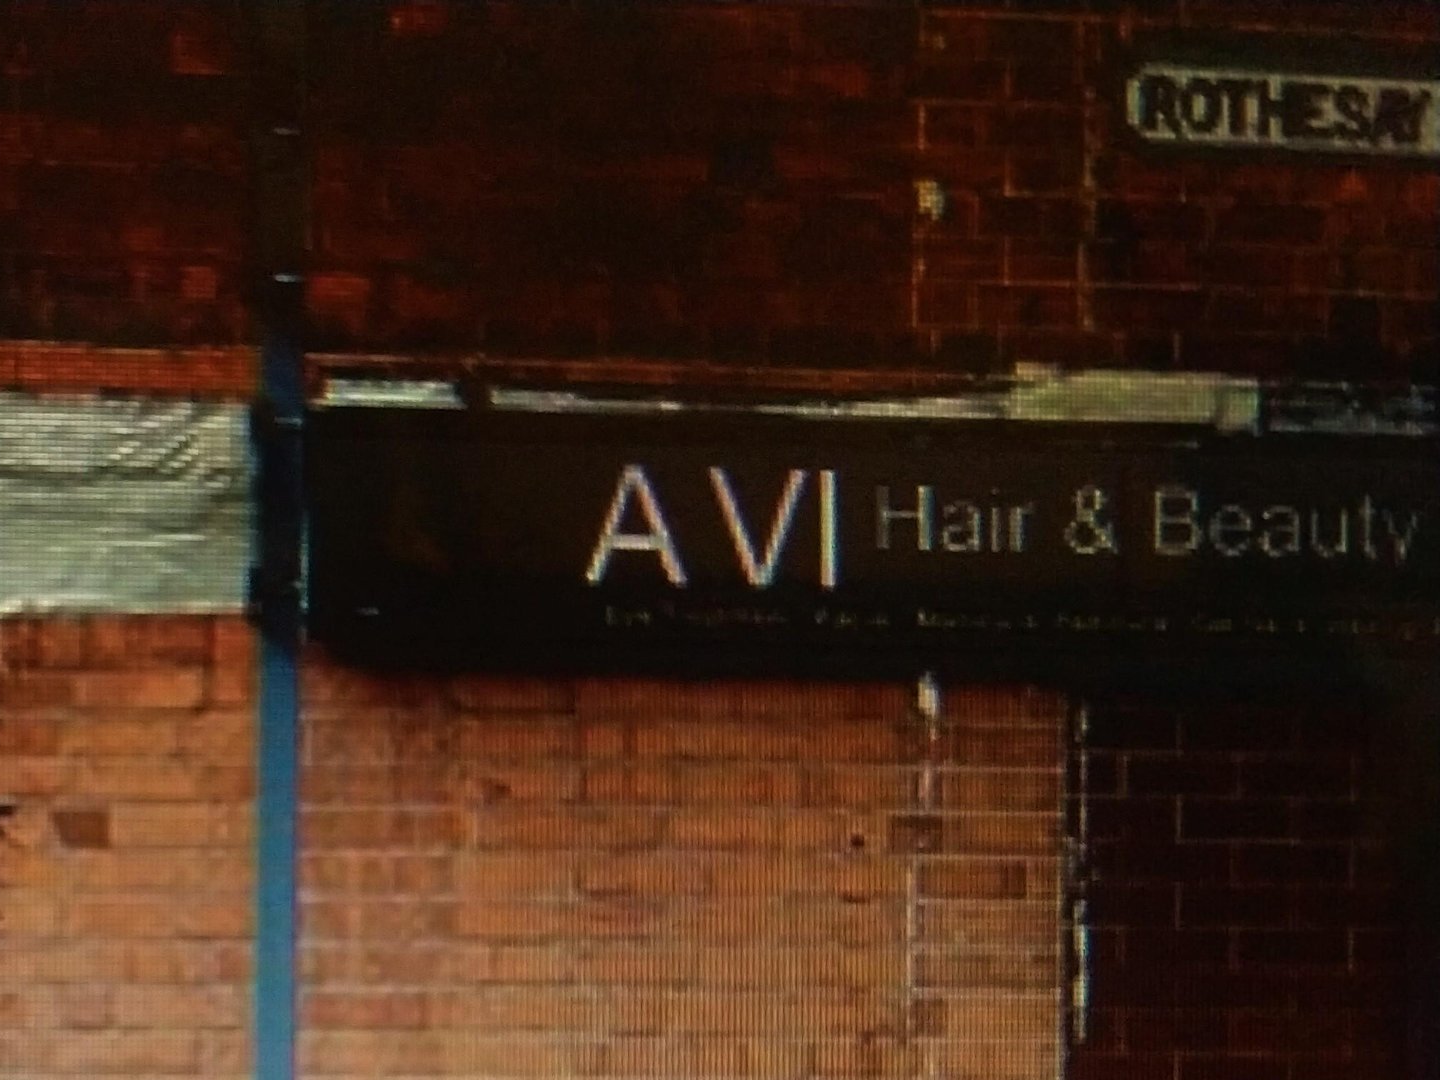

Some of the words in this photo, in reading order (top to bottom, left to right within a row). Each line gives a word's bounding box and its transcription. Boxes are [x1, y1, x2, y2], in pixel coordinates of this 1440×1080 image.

[585, 463, 841, 590] AVI
[874, 484, 1037, 555] Hair
[1065, 484, 1119, 557] &
[1153, 484, 1421, 567] Beauty
